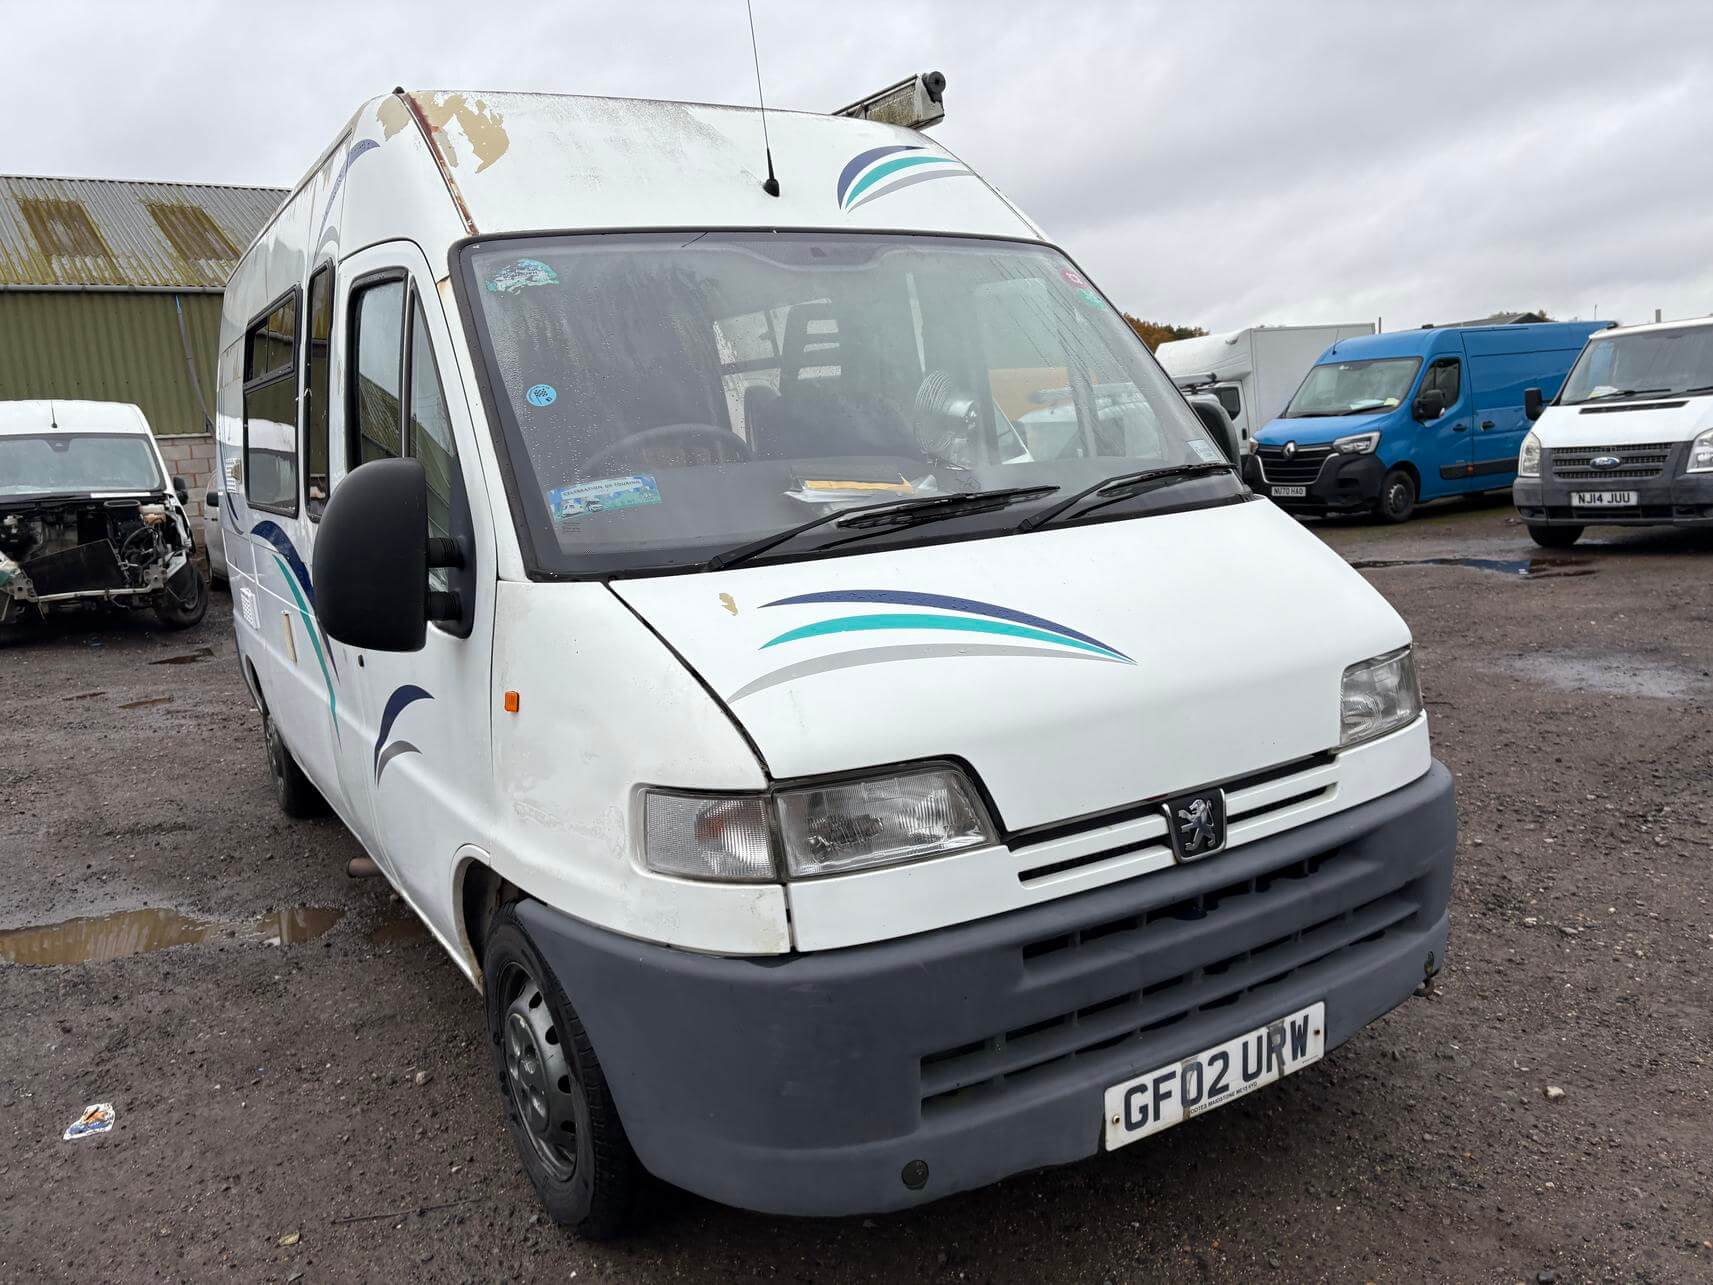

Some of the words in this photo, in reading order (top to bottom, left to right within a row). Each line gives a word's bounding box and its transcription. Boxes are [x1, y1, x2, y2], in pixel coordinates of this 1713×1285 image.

[1578, 493, 1603, 504] NJ14
[1607, 492, 1631, 503] JUU
[1124, 1050, 1230, 1132] GF02
[1242, 1014, 1309, 1082] URW
